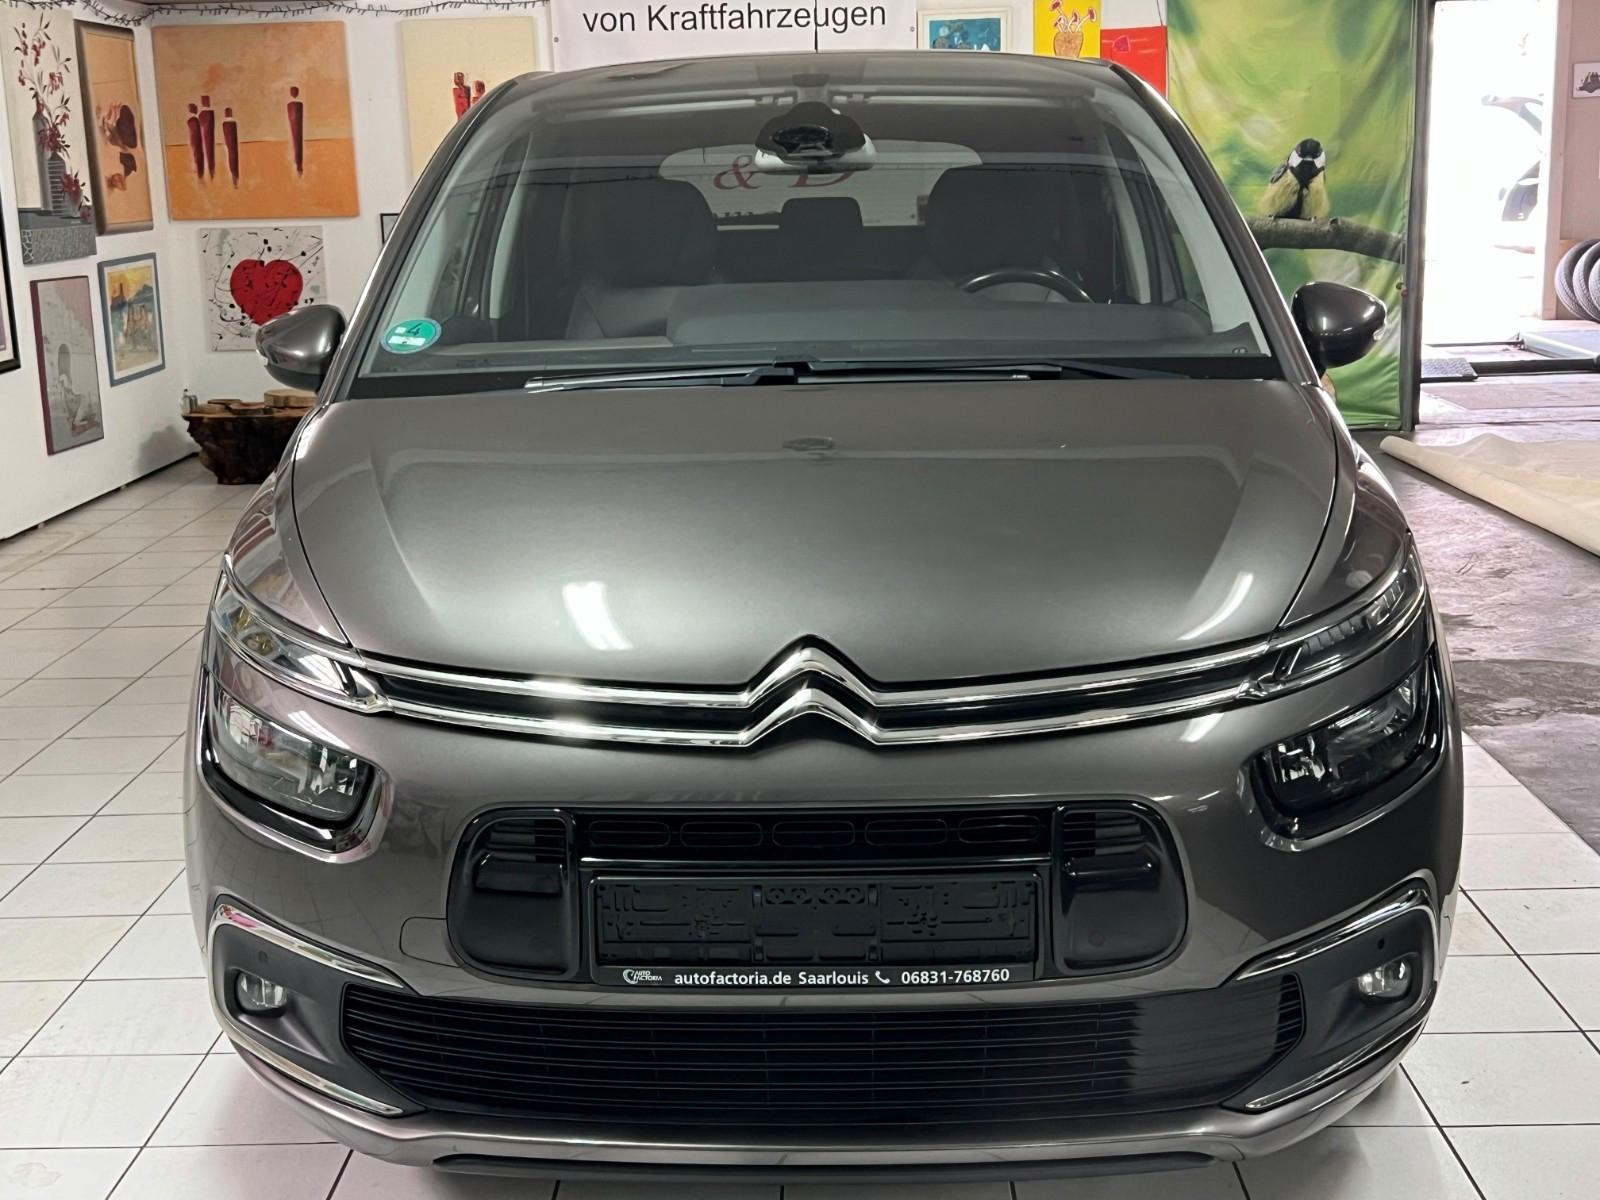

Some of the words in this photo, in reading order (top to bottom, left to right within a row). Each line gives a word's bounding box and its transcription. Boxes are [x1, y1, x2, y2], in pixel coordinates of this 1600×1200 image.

[582, 11, 636, 32] von
[647, 2, 886, 34] Kraftfahrzeugen
[713, 154, 762, 190] &
[406, 322, 422, 337] 4
[674, 970, 792, 985] autofactoria.de
[798, 970, 869, 985] Saarlouis
[900, 968, 1010, 984] 06831-768760
